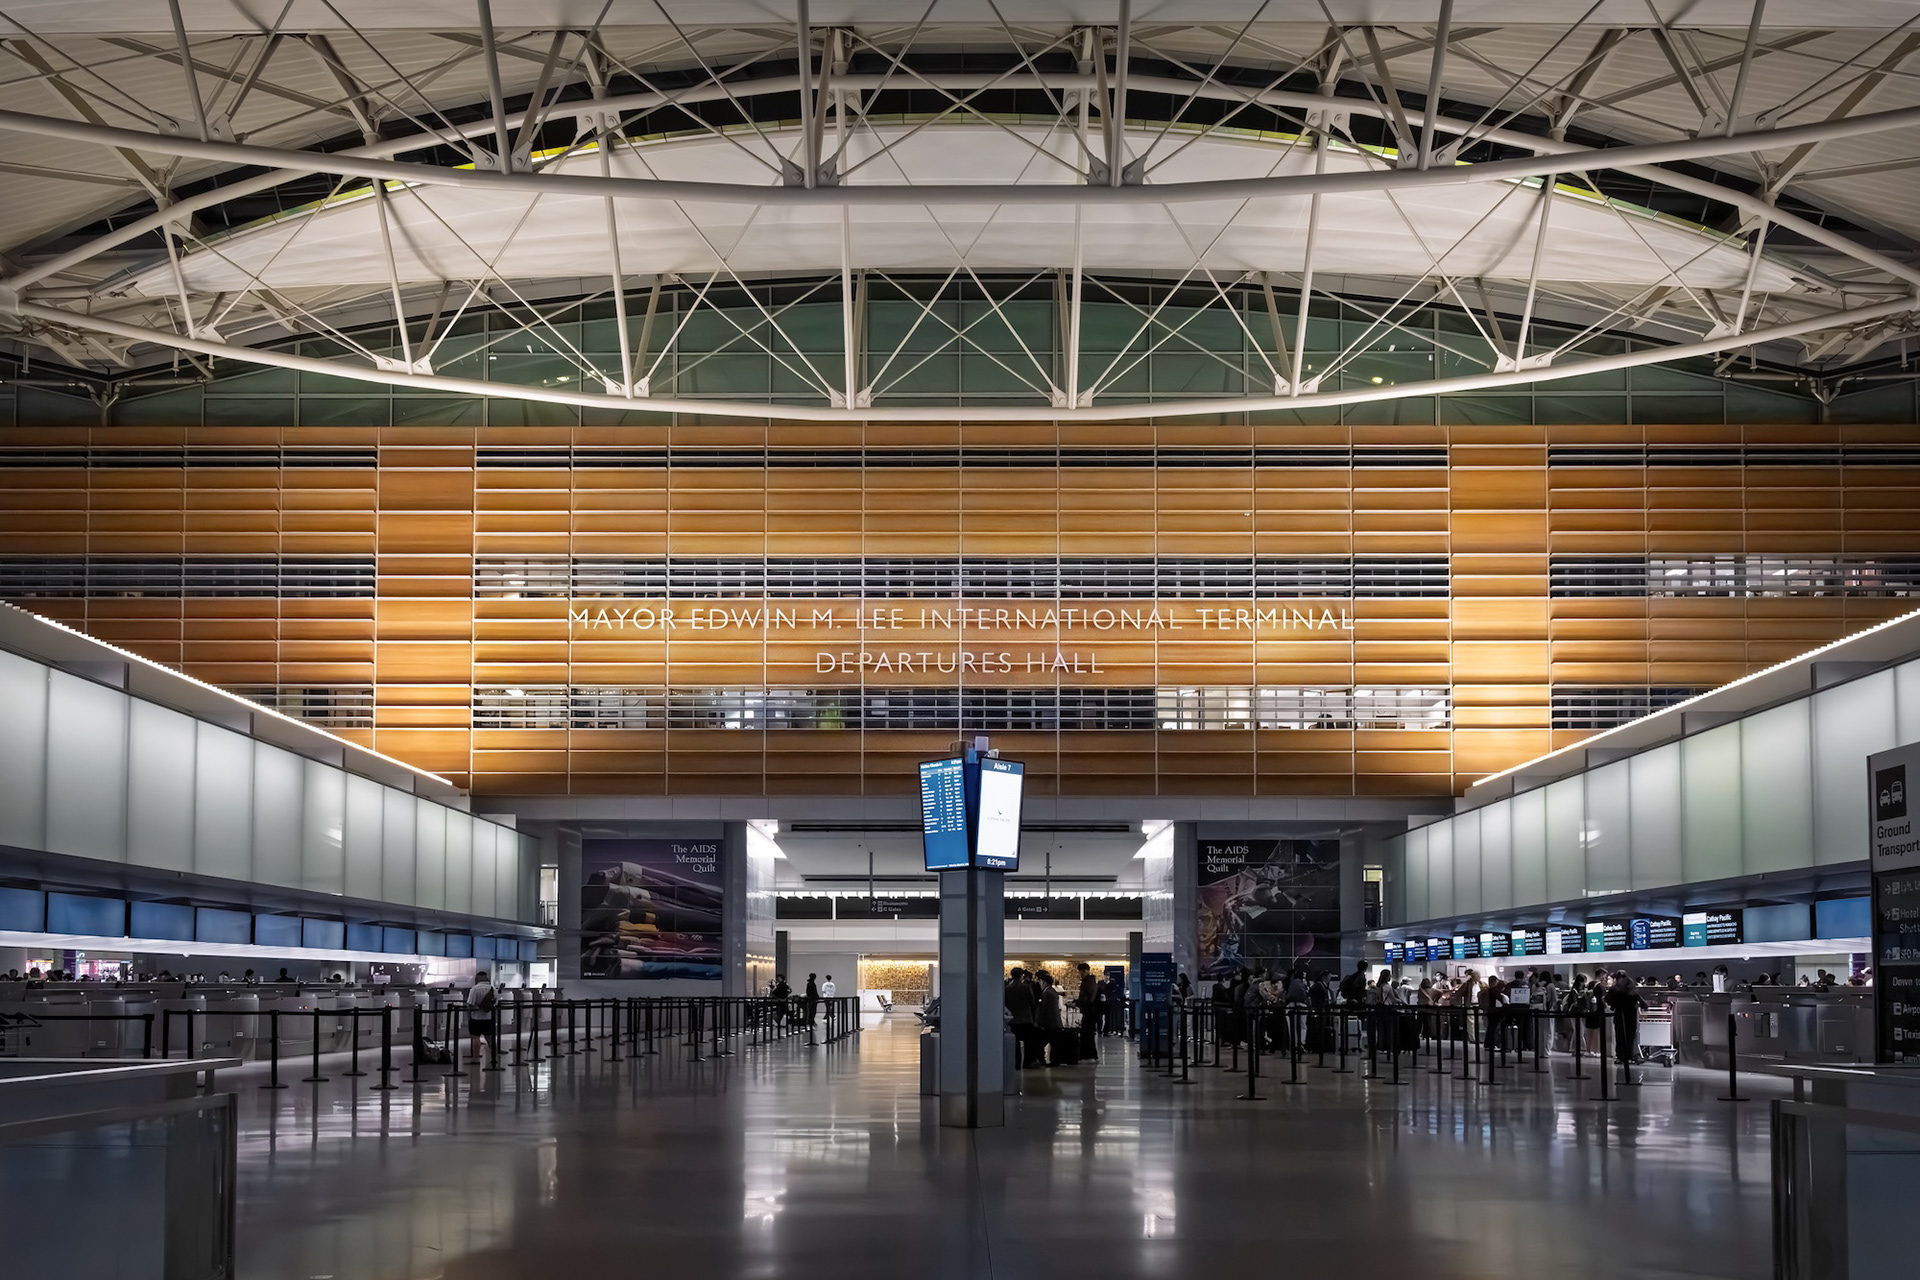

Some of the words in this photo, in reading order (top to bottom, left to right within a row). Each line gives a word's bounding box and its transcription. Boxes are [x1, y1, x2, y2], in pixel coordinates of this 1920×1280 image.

[568, 608, 676, 630] MAYOR
[691, 608, 796, 630] EDWIN
[812, 608, 842, 630] M.
[856, 608, 904, 630] LEE
[920, 608, 1183, 630] INTERNATIONAL
[1196, 608, 1355, 630] TERMINAL
[816, 652, 1012, 673] DEPARTURES
[1027, 652, 1105, 673] HALL
[1877, 821, 1911, 839] Ground
[671, 844, 688, 853] The
[690, 844, 717, 853] AIDS
[1207, 845, 1222, 854] The
[1224, 845, 1249, 854] AIDS
[1877, 840, 1920, 857] Transport
[675, 854, 716, 863] Memorial
[1207, 855, 1245, 864] Memorial
[692, 863, 716, 874] Quilt
[1207, 864, 1229, 874] Quilt
[1900, 907, 1919, 919] Hotel
[1892, 976, 1913, 987] Down
